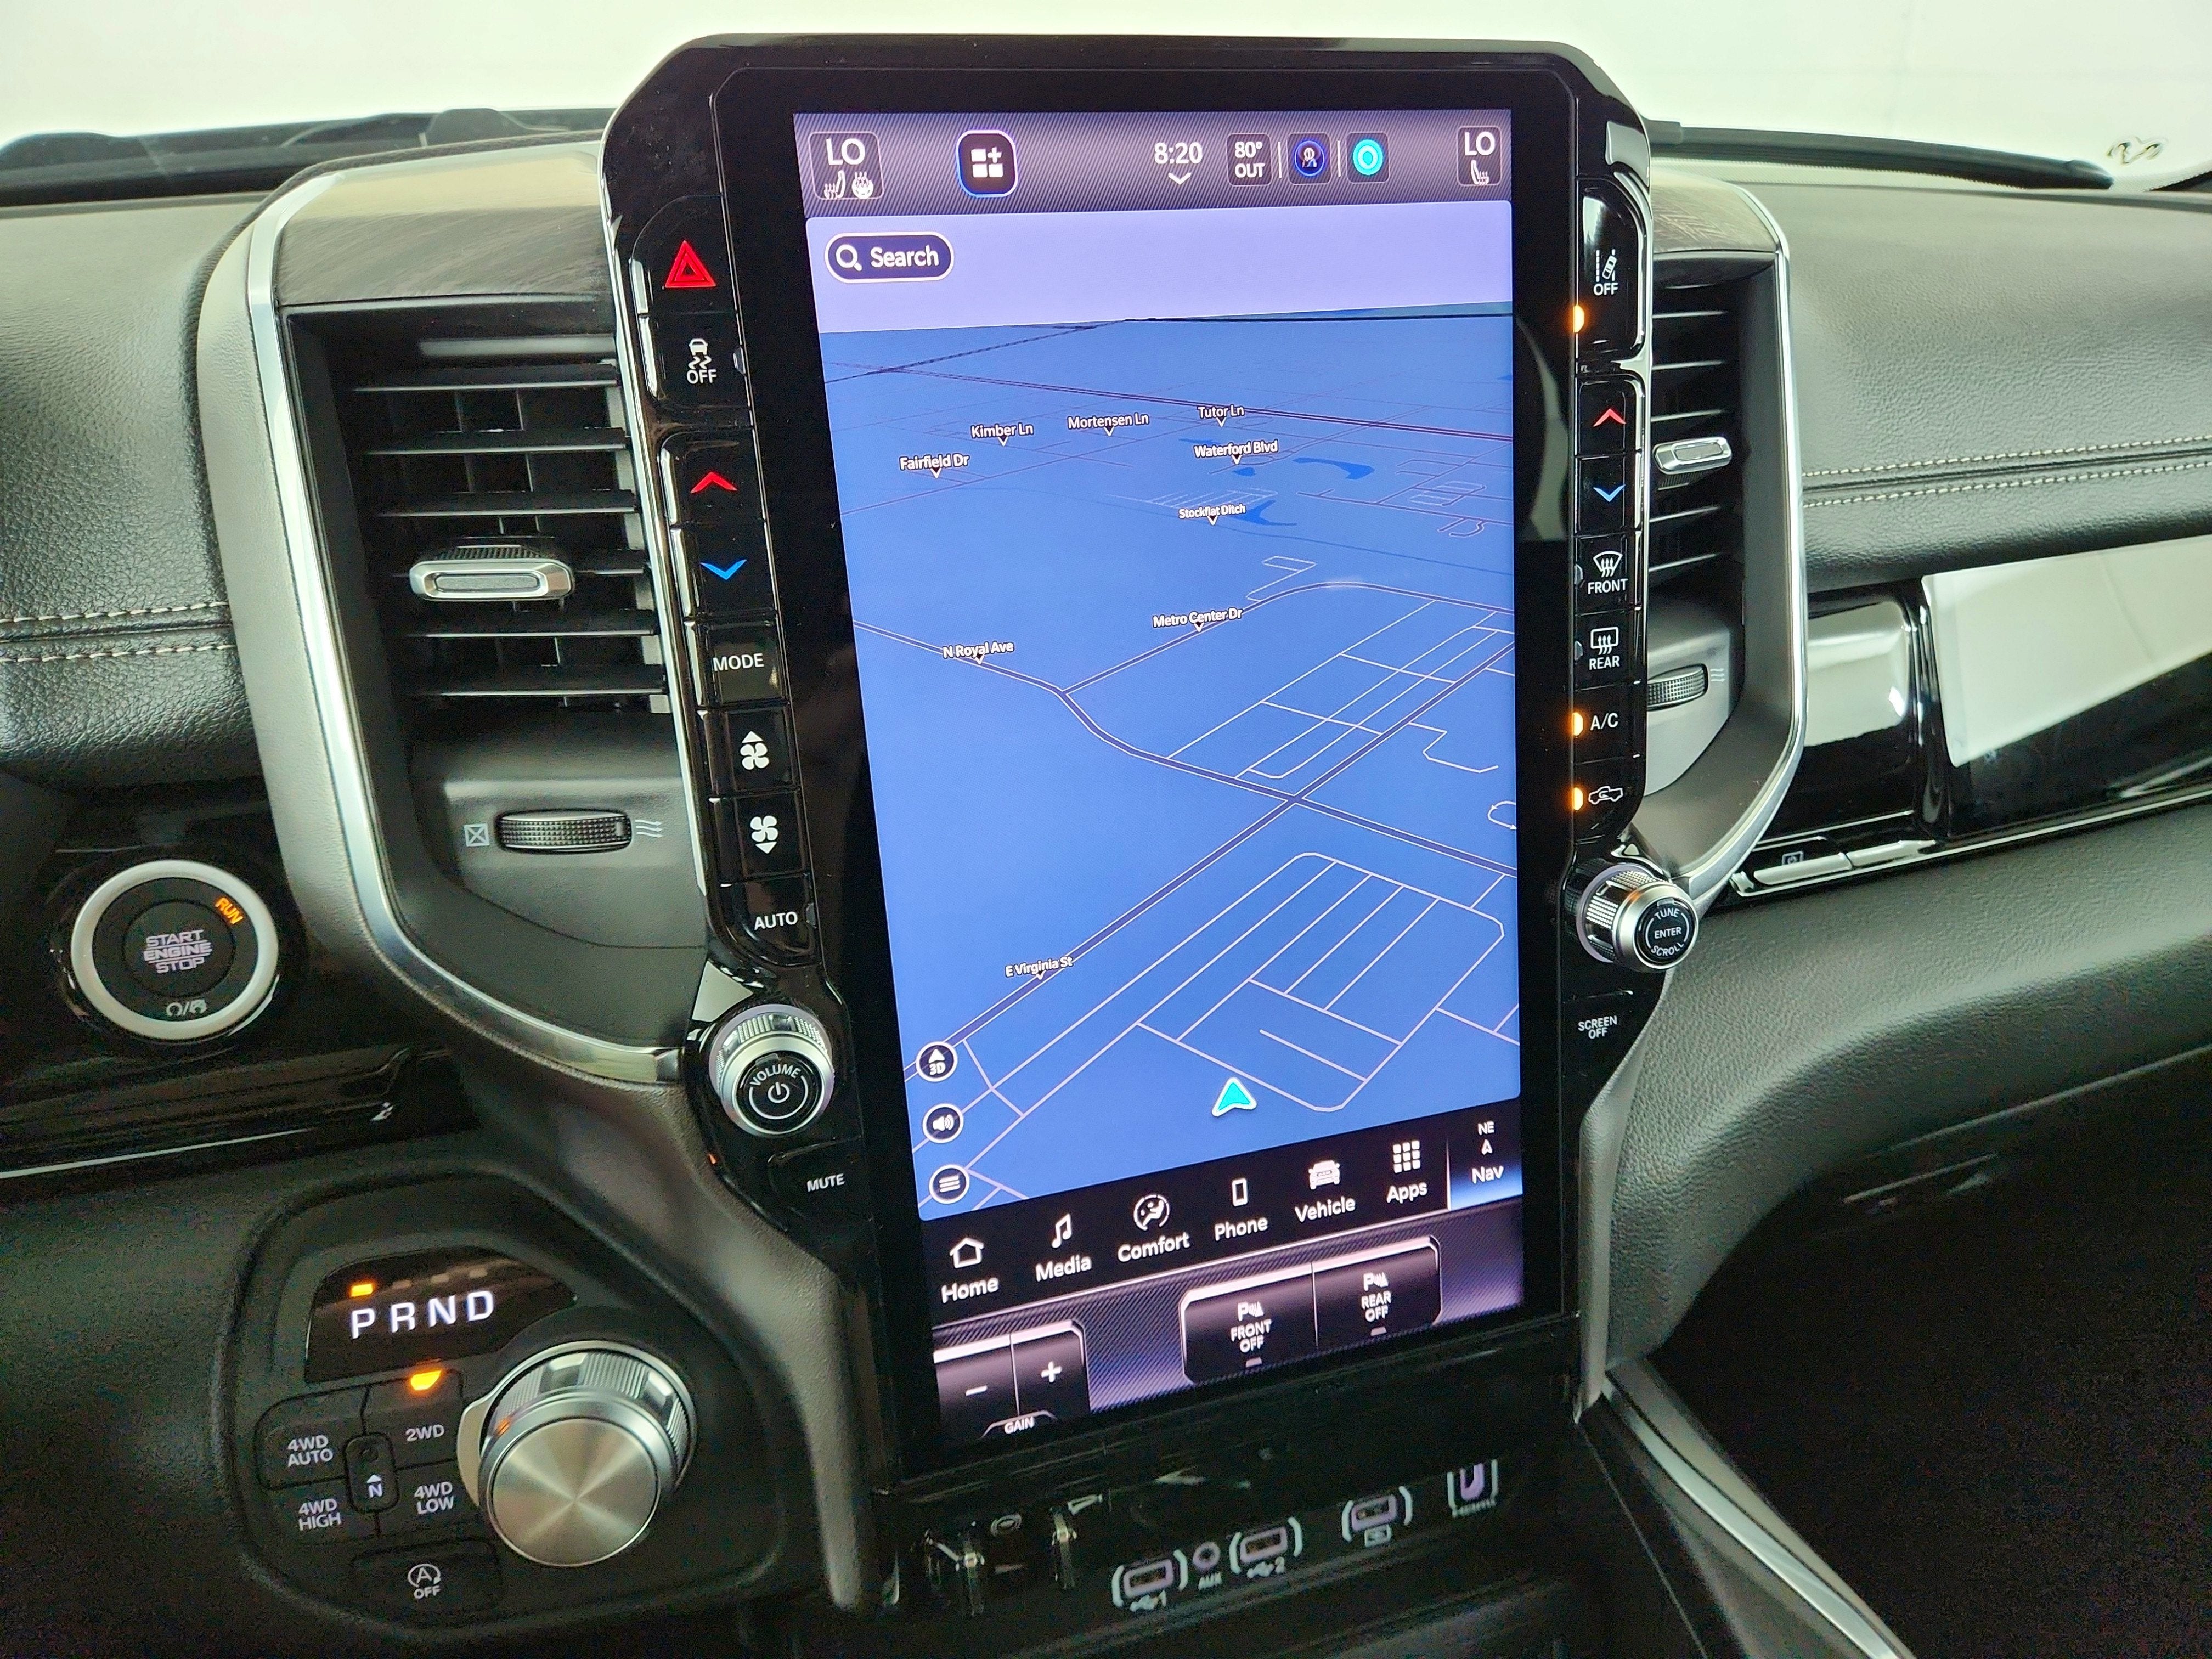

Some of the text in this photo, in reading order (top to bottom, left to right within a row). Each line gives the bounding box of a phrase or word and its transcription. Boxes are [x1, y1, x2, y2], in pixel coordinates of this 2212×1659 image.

[826, 138, 865, 165] LO
[1234, 141, 1263, 159] 80°
[1464, 132, 1495, 156] LO
[1154, 142, 1203, 165] 8:20
[1234, 162, 1266, 178] OUT
[870, 245, 939, 267] Search
[1593, 282, 1619, 296] OFF
[686, 369, 717, 384] OFF
[1198, 405, 1244, 418] Tutor Ln
[1068, 414, 1149, 429] Mortensen Ln
[972, 424, 1034, 438] Kimber Ln
[1194, 441, 1278, 458] Waterford Blvd
[900, 454, 969, 470] Fairfield Dr
[1179, 504, 1246, 518] Stockflat Ditch
[1587, 578, 1628, 595] FRONT
[1153, 608, 1243, 628] Metro Center Dr
[943, 642, 1014, 658] N Royal Ave
[713, 653, 765, 672] MODE
[1589, 655, 1621, 670] REAR
[1590, 713, 1619, 731] A/C
[216, 898, 244, 924] RUN
[1654, 908, 1680, 921] TUNE
[754, 911, 798, 930] AUTO
[146, 929, 204, 947] START
[1654, 927, 1682, 939] ENTER
[143, 941, 213, 961] ENGINE
[1651, 942, 1684, 956] SCROLL
[156, 956, 205, 974] STOP
[1006, 956, 1073, 977] E Virginia St
[1578, 1015, 1617, 1031] SCREEN
[1588, 1027, 1608, 1040] OFF
[749, 1064, 802, 1087] VOLUME
[929, 1063, 946, 1075] 3D
[1478, 1121, 1494, 1135] NE
[806, 1173, 845, 1193] MUTE
[1471, 1165, 1504, 1184] Nav
[1387, 1182, 1427, 1204] Apps
[1295, 1195, 1356, 1222] Vehicle
[1214, 1216, 1268, 1240] Phone
[1118, 1232, 1190, 1262] Comfort
[1035, 1255, 1092, 1282] Media
[941, 1277, 999, 1304] Home
[1361, 1290, 1392, 1310] REAR
[1365, 1305, 1389, 1322] OFF
[1231, 1318, 1272, 1342] FRONT
[1239, 1335, 1263, 1353] OFF
[405, 1423, 445, 1442] 2WD
[1004, 1416, 1035, 1435] GAIN
[287, 1435, 329, 1452] 4WD
[287, 1448, 334, 1468] AUTO
[368, 1483, 383, 1498] N
[414, 1481, 454, 1499] 4WD
[298, 1498, 337, 1515] 4WD
[417, 1497, 454, 1515] LOW
[298, 1511, 342, 1531] HIGH
[414, 1585, 441, 1599] OFF
